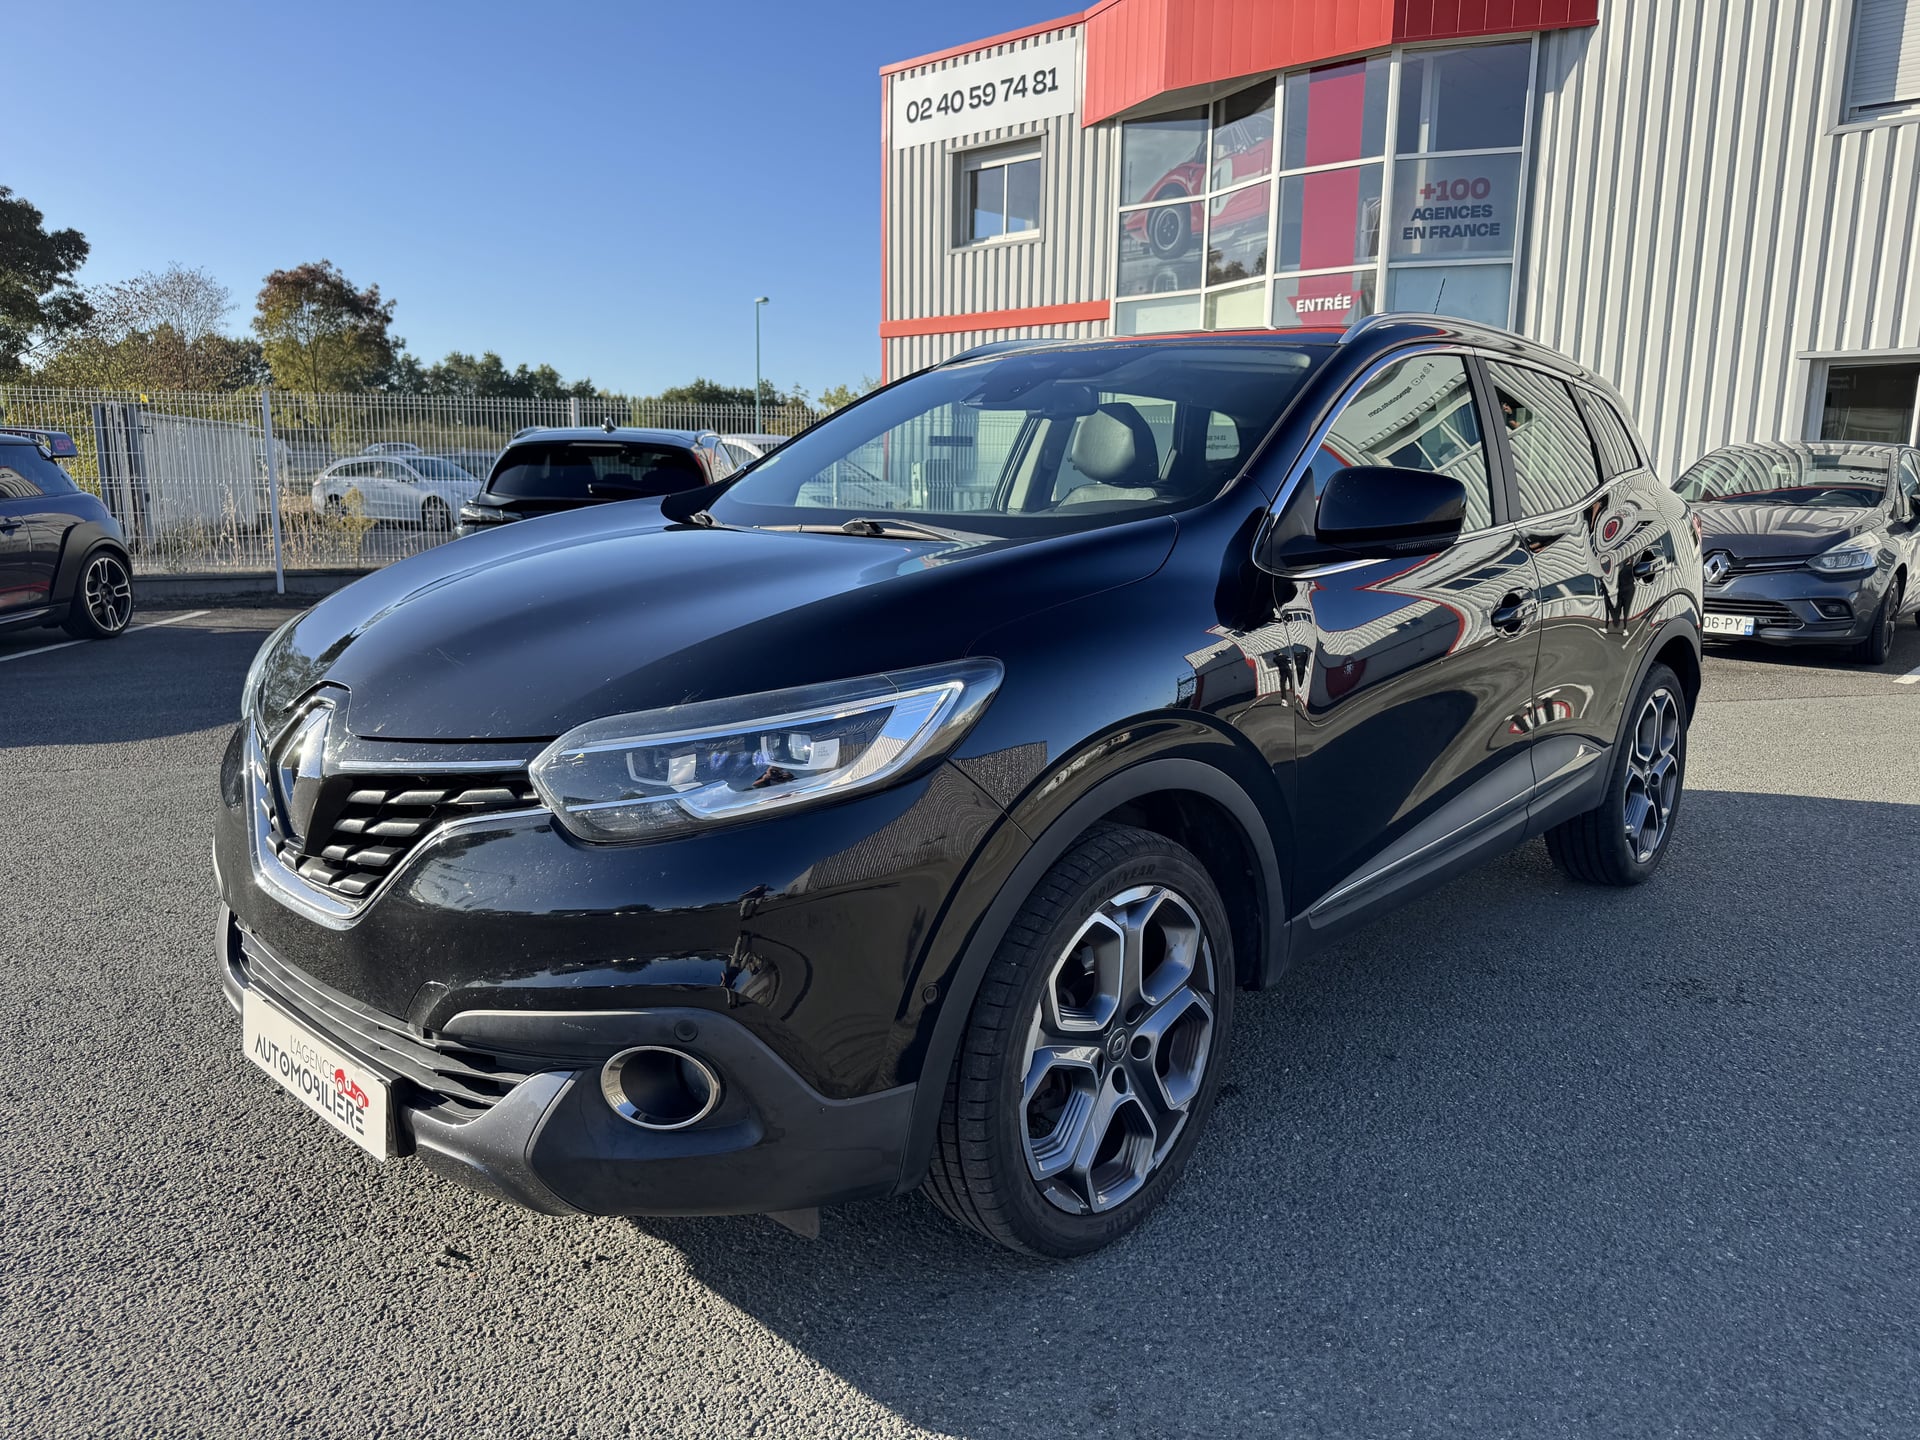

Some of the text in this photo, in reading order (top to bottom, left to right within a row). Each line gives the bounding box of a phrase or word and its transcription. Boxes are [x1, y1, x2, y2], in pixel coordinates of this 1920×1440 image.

[906, 67, 1059, 124] 02 40 59 74 81
[1419, 177, 1491, 202] +100
[1411, 204, 1493, 222] AGENCES
[1402, 222, 1501, 240] EN FRANCE
[1295, 293, 1352, 313] ENTRÉE
[290, 1034, 336, 1084] L'AGENCE
[255, 1032, 365, 1136] AUTOMOBILIERE
